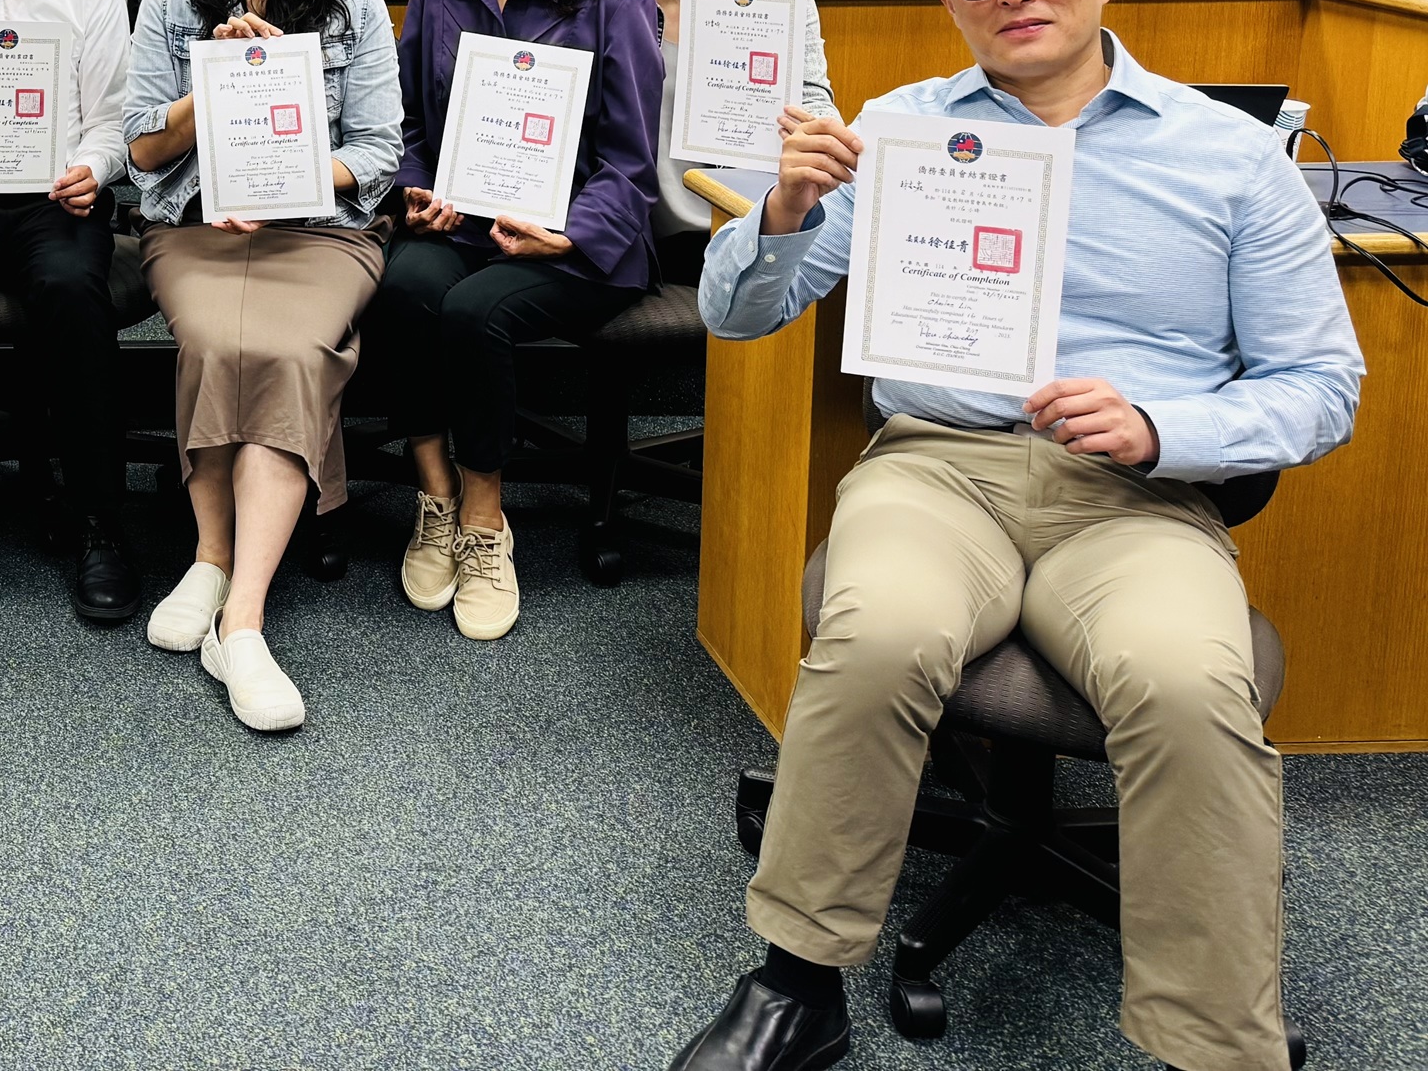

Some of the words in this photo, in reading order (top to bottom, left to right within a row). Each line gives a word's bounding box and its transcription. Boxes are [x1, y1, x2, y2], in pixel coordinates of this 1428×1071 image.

[902, 267, 946, 277] Certificate
[949, 273, 959, 281] of
[959, 273, 1009, 285] Completion
